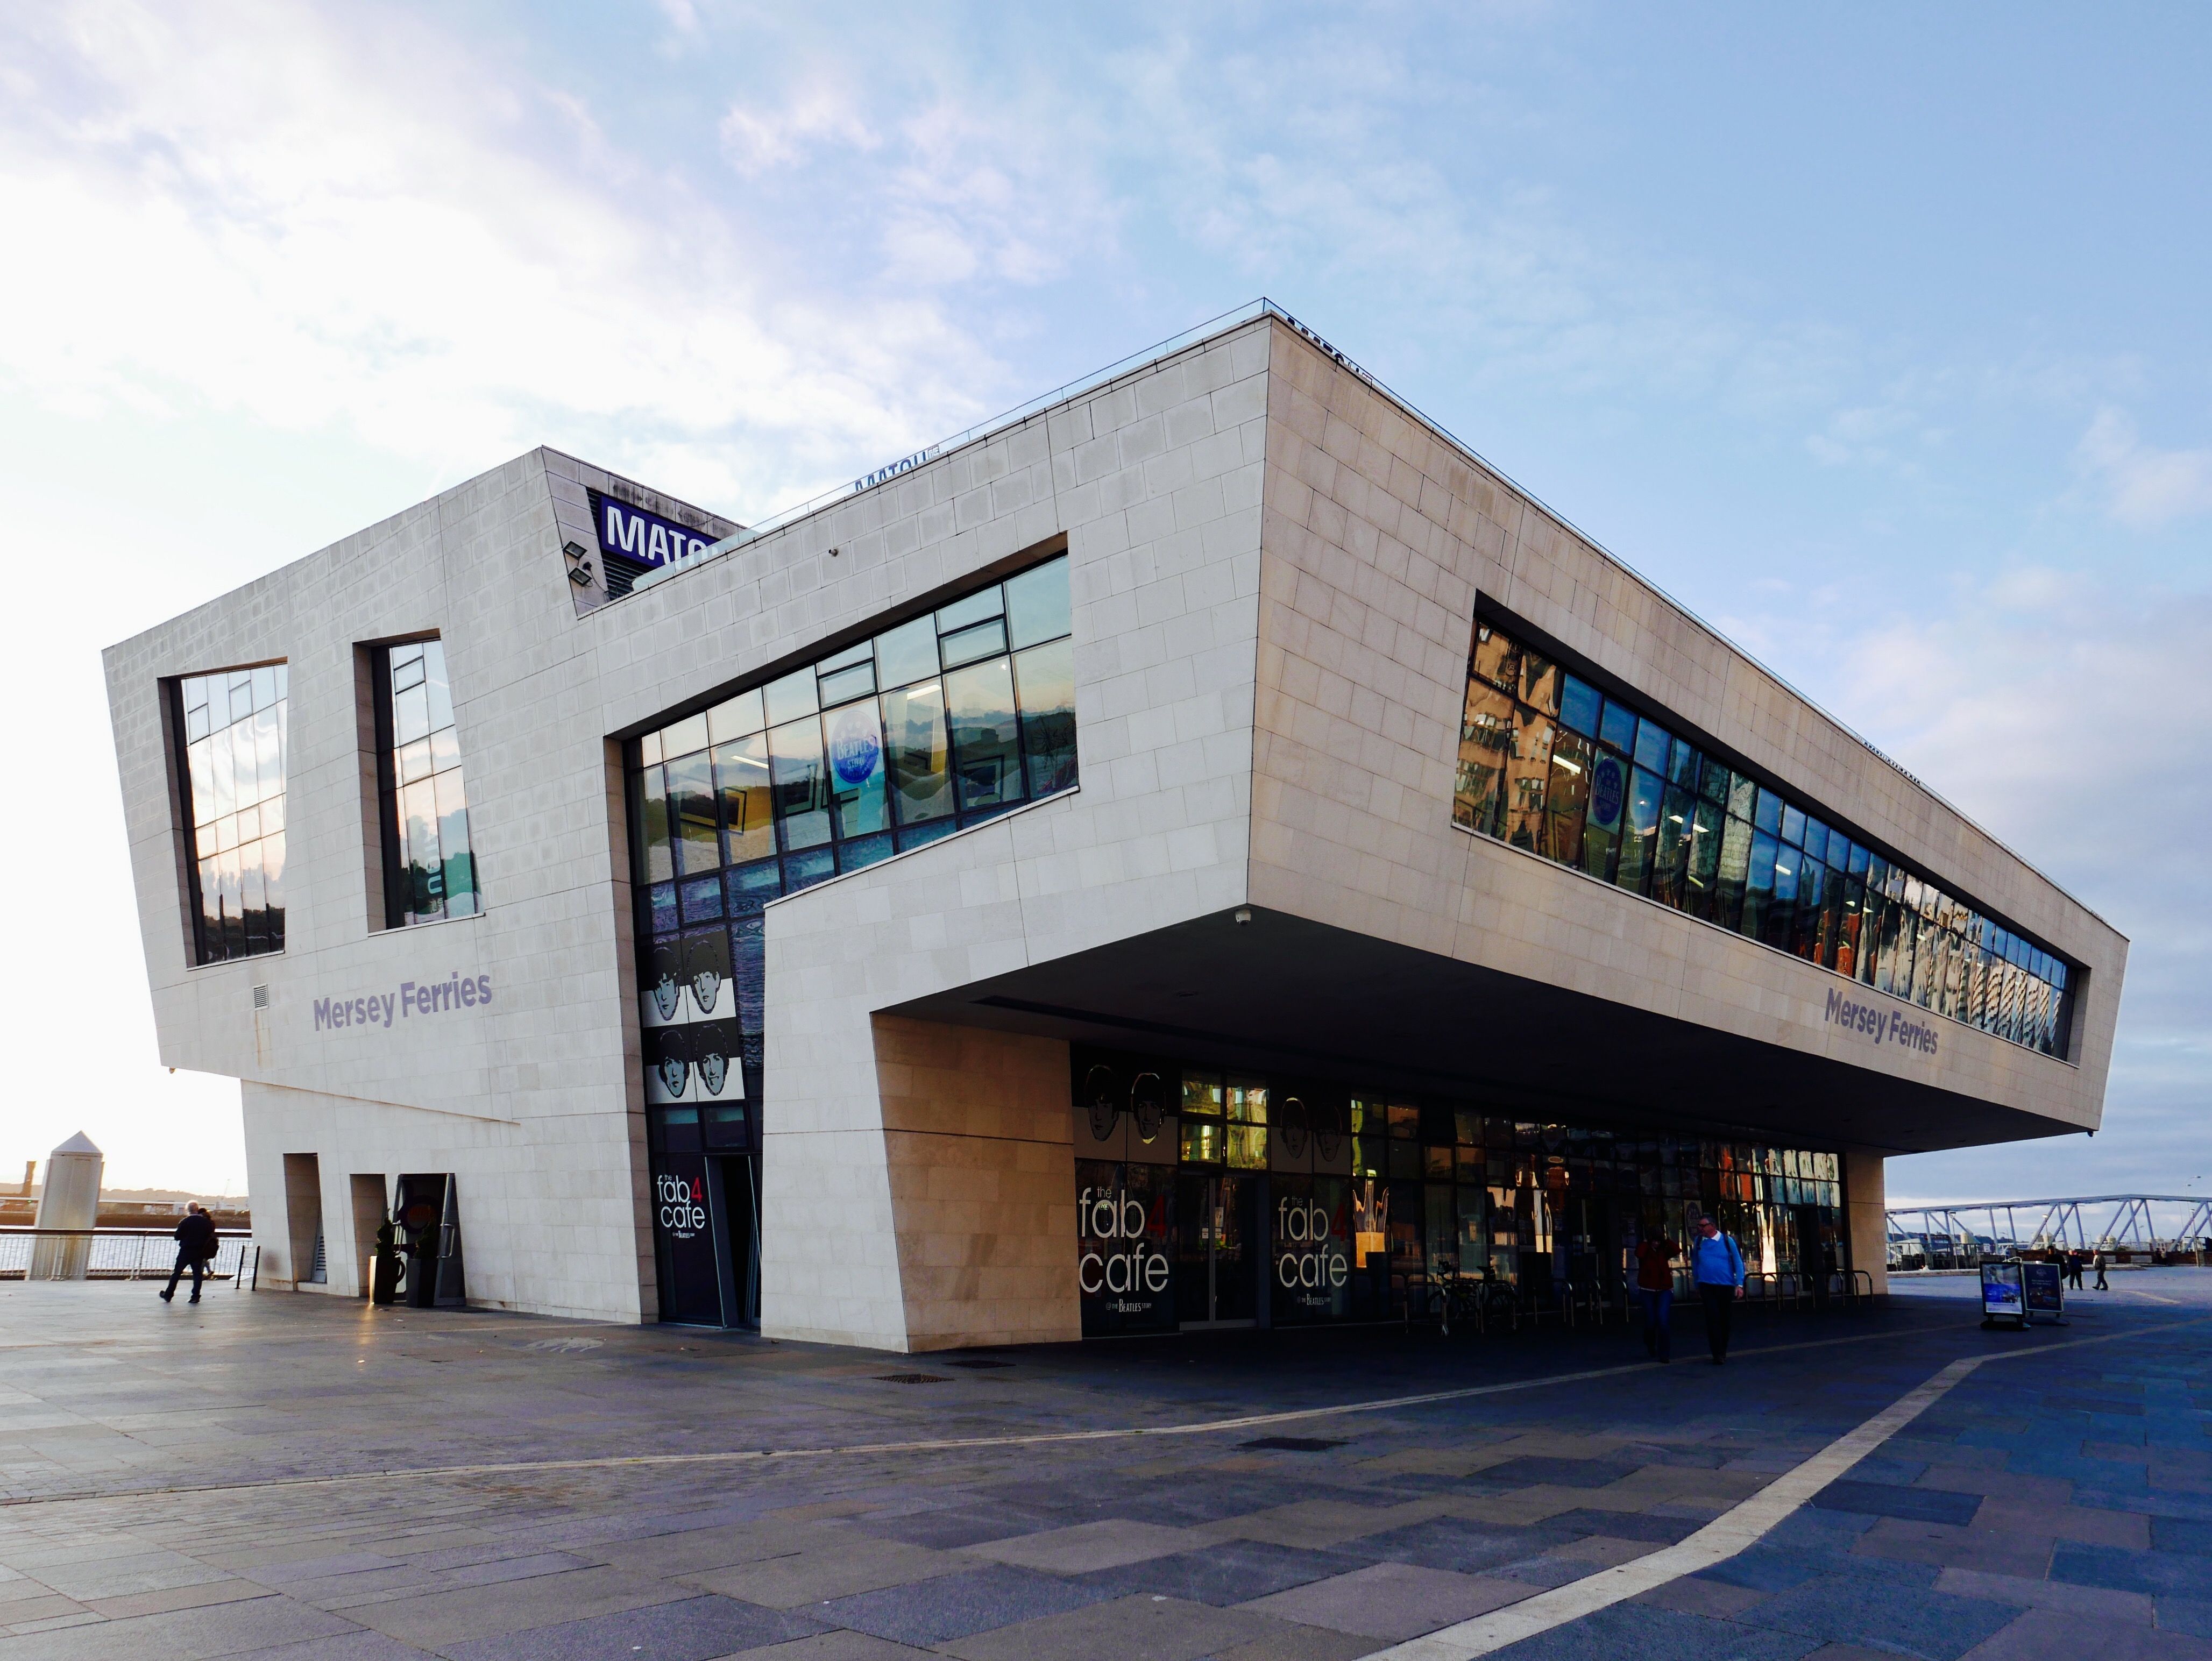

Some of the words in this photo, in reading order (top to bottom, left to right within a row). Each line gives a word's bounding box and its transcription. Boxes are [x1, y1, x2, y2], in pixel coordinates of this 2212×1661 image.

[607, 506, 719, 570] MATO
[836, 737, 875, 760] BEATLES
[314, 992, 395, 1031] Mersey
[400, 971, 493, 1018] Ferries
[1825, 988, 1887, 1044] Mersey
[1889, 1010, 1938, 1055] Ferries
[1097, 1186, 1112, 1198] the
[1291, 1196, 1303, 1206] the
[661, 1201, 705, 1229] cafe
[1079, 1242, 1169, 1293] cafe
[1279, 1244, 1348, 1288] cafe
[1119, 1298, 1142, 1312] BEATLES
